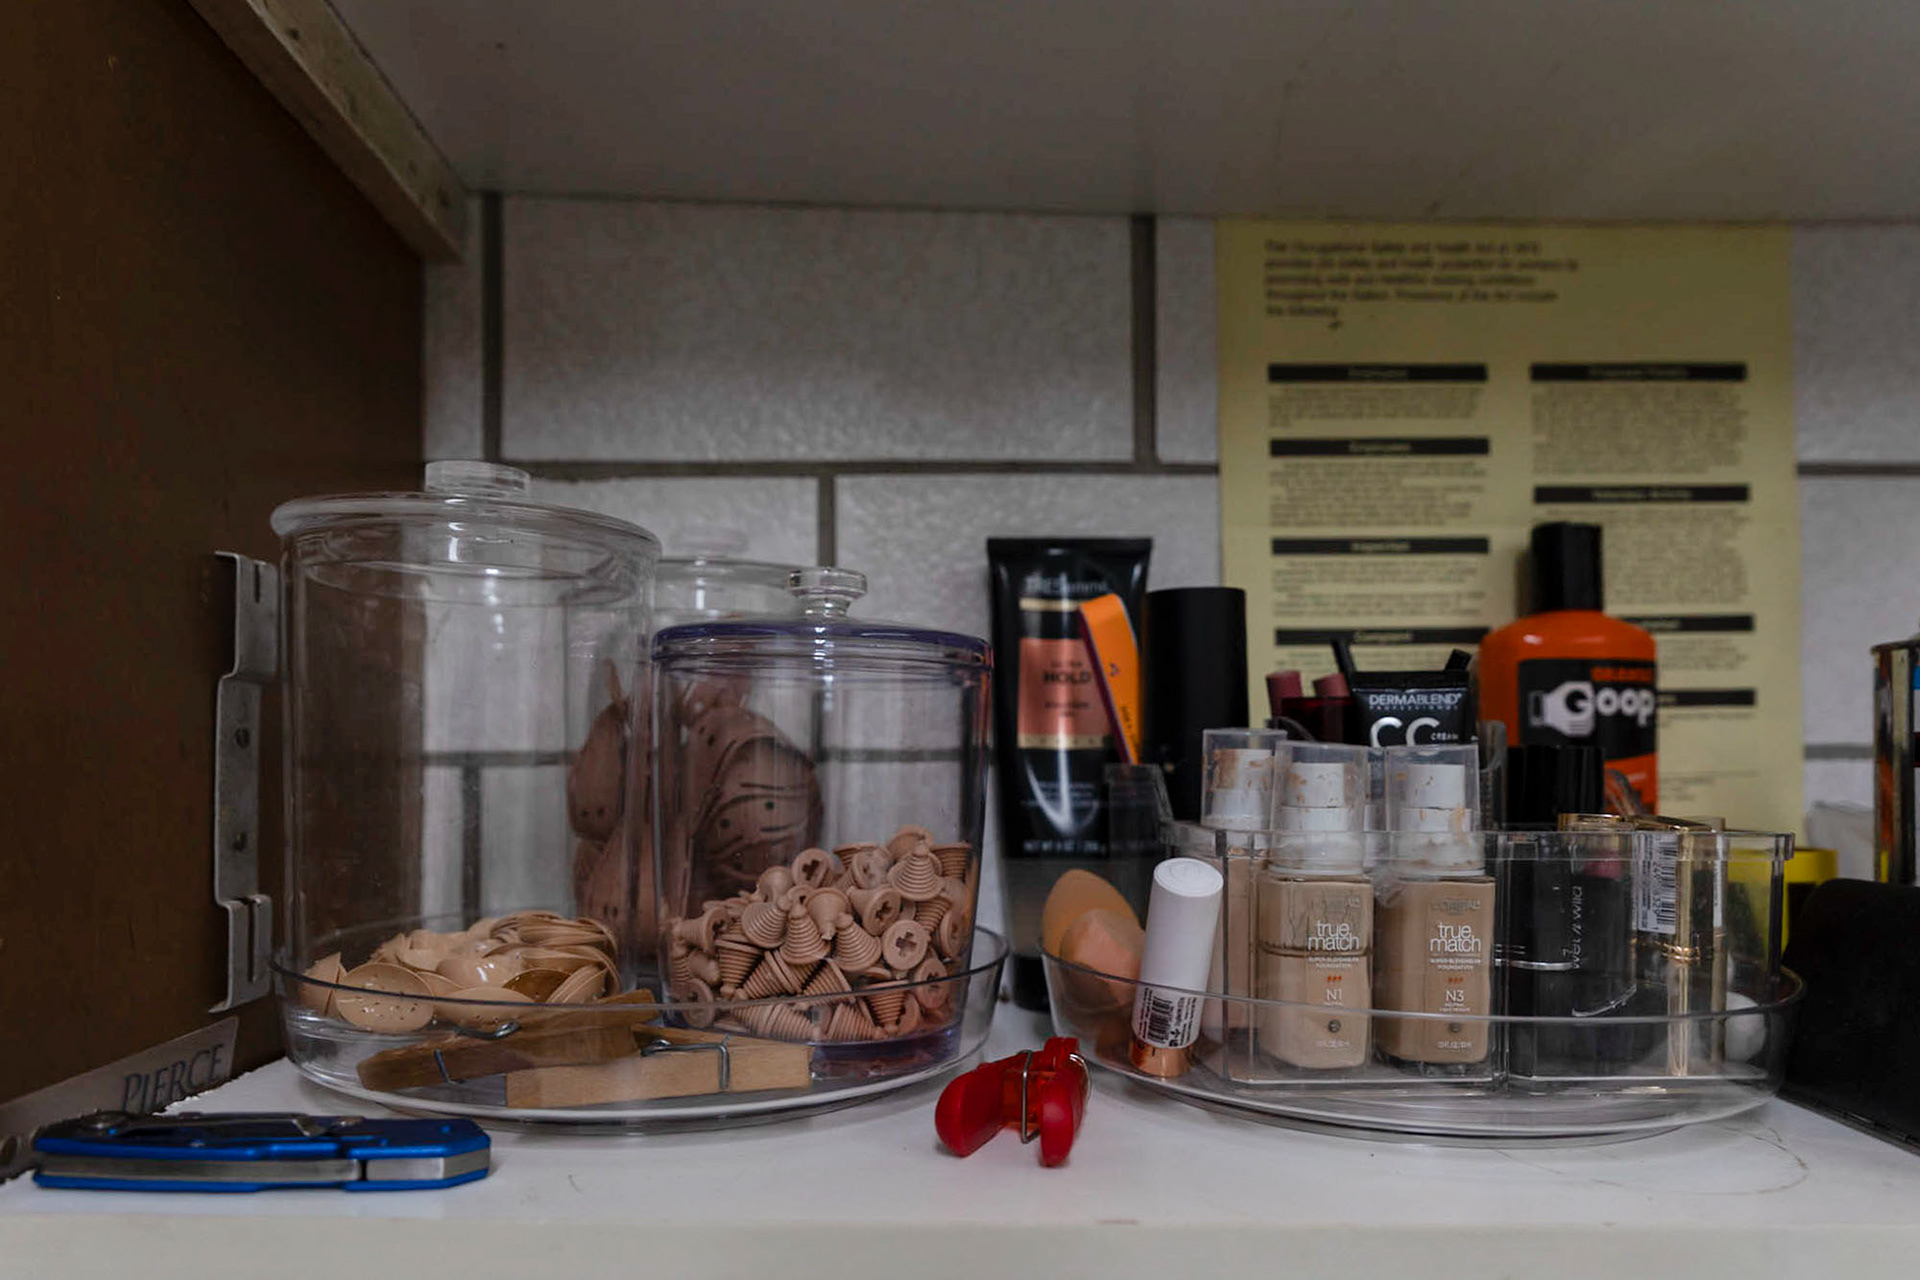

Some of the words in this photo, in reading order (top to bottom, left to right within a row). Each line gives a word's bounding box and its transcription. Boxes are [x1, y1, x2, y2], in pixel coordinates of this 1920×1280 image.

[1043, 670, 1092, 684] HOLD
[1369, 694, 1459, 706] DERMABLEND
[1370, 716, 1440, 747] CC
[1316, 920, 1350, 937] true
[1438, 922, 1472, 939] true
[1308, 933, 1360, 951] match
[1430, 935, 1482, 953] match
[1327, 988, 1343, 1001] N1
[1446, 990, 1465, 1002] N3
[122, 1044, 224, 1114] PIERCE
